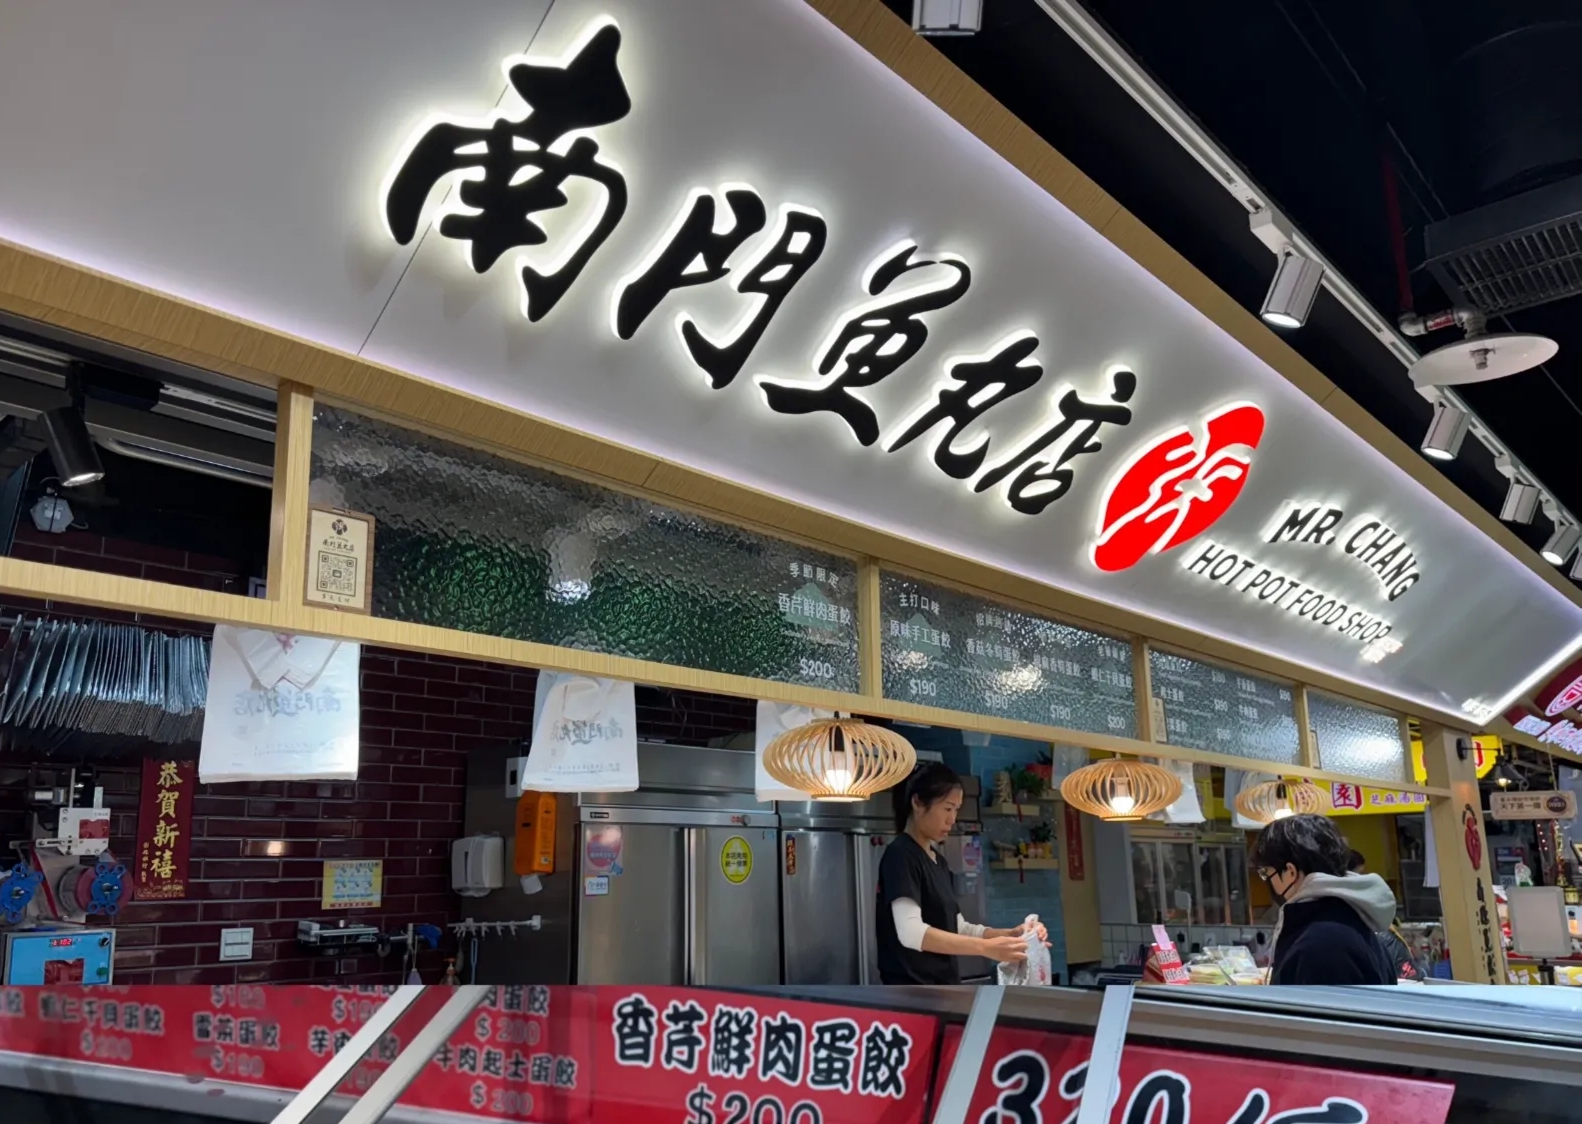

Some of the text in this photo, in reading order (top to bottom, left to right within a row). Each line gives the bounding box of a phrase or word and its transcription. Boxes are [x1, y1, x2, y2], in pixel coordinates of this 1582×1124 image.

[385, 22, 1137, 516] 南門魚丸店
[1267, 505, 1421, 602] MR. CHANG
[789, 562, 840, 589] 季節限定
[778, 592, 851, 626] 香芹鮮肉蛋餃
[898, 593, 941, 616] 主打口味
[1187, 543, 1393, 643] HOT POT FOOD SHOP
[890, 620, 952, 649] 原味手工蛋餃
[800, 658, 832, 679] $200
[909, 679, 937, 697] $190
[150, 760, 183, 879] 恭賀新禧
[613, 992, 913, 1099] 香芹鮮肉蛋餃
